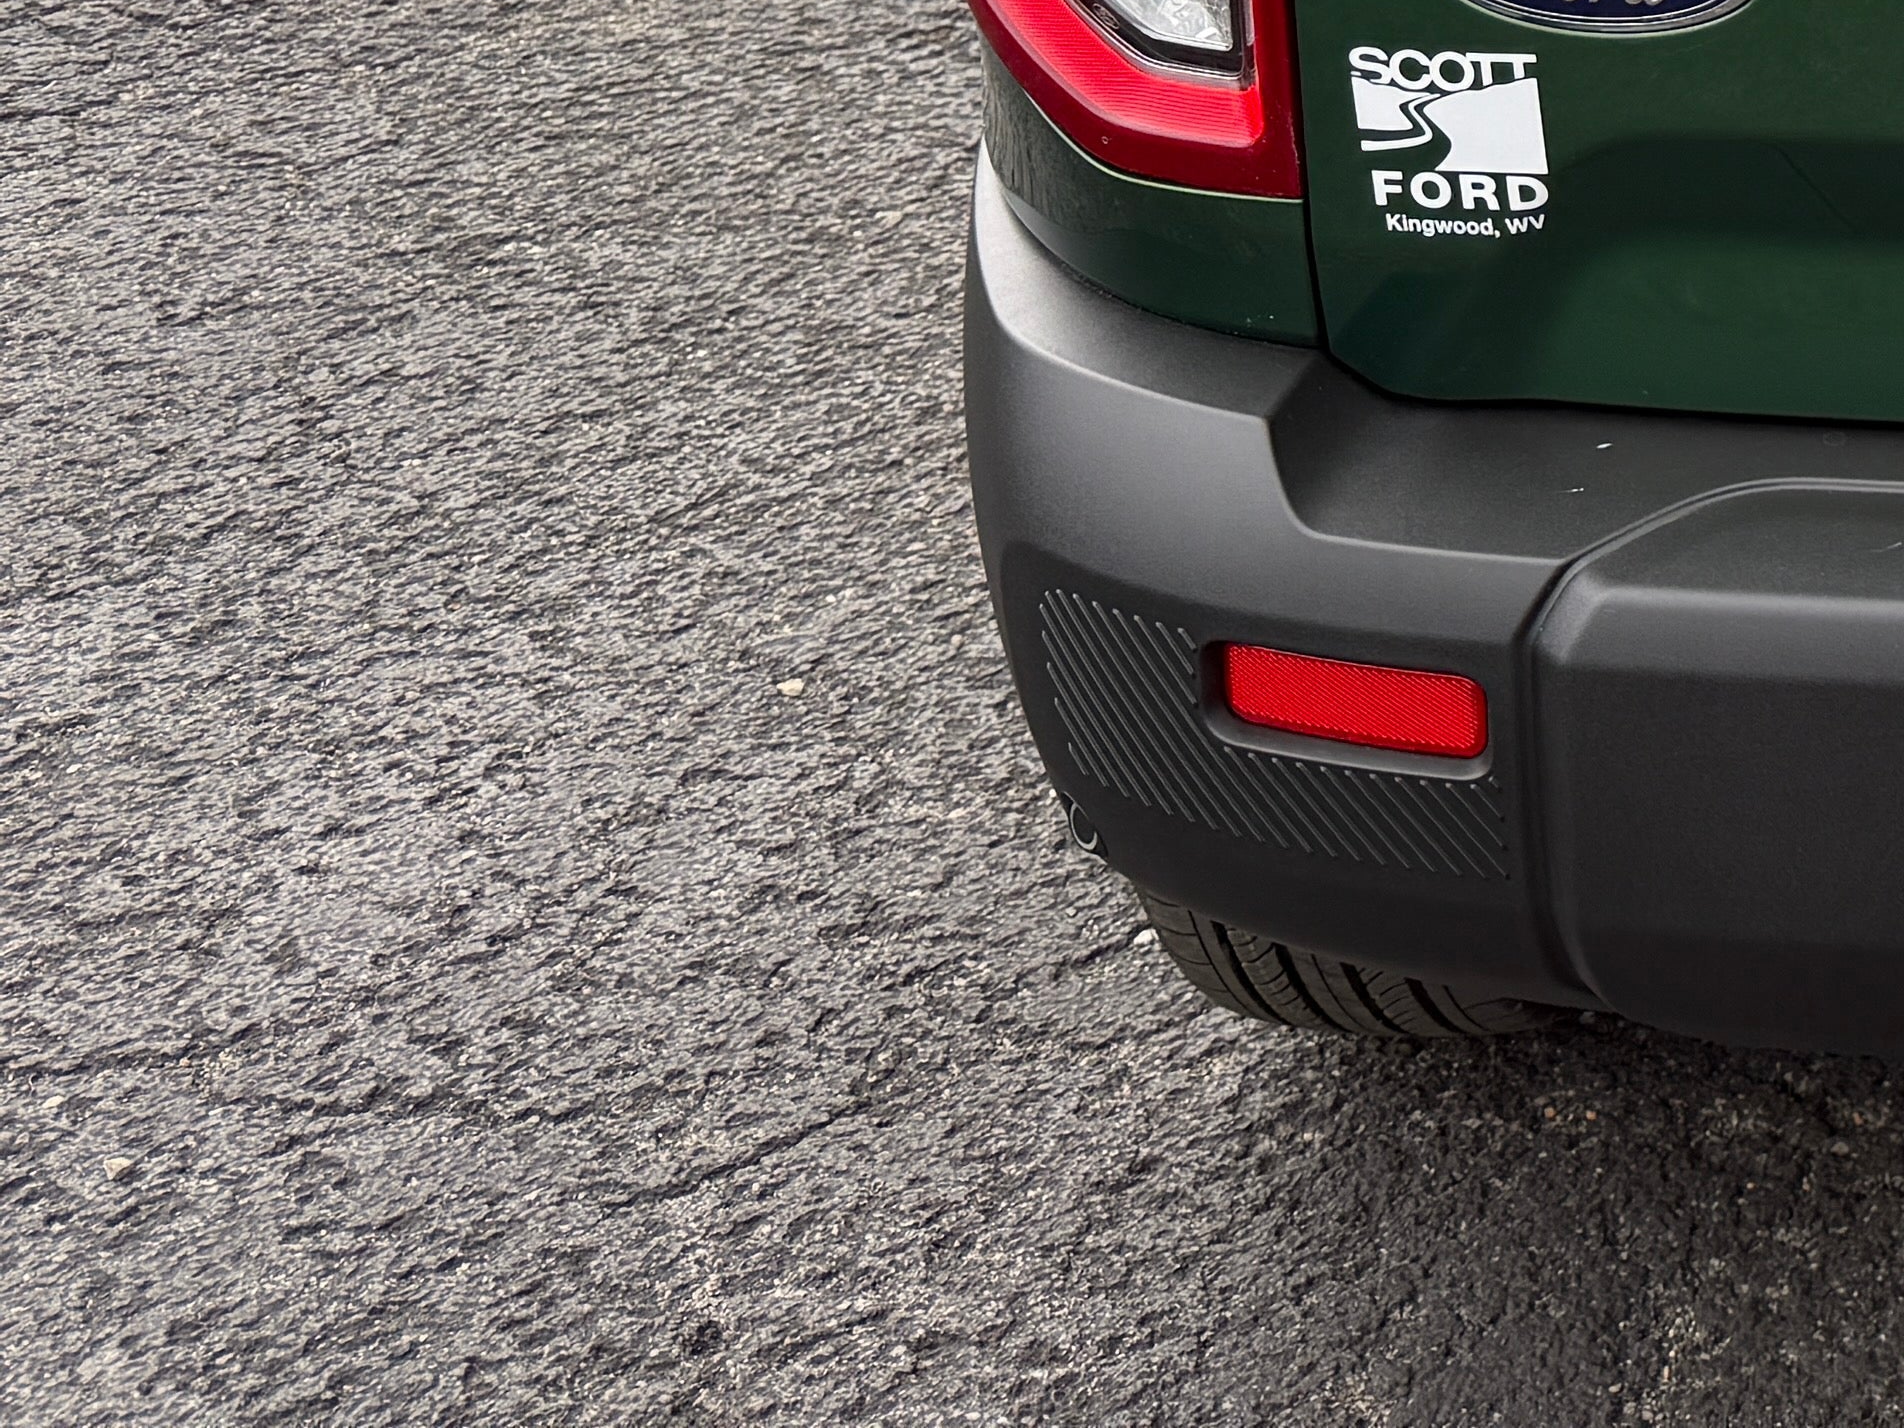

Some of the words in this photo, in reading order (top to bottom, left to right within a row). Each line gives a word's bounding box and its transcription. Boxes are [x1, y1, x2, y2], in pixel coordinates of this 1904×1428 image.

[1348, 46, 1537, 92] SCOTT
[1371, 170, 1549, 212] FORD
[1385, 213, 1501, 239] Kingwood,
[1504, 214, 1546, 235] WV
